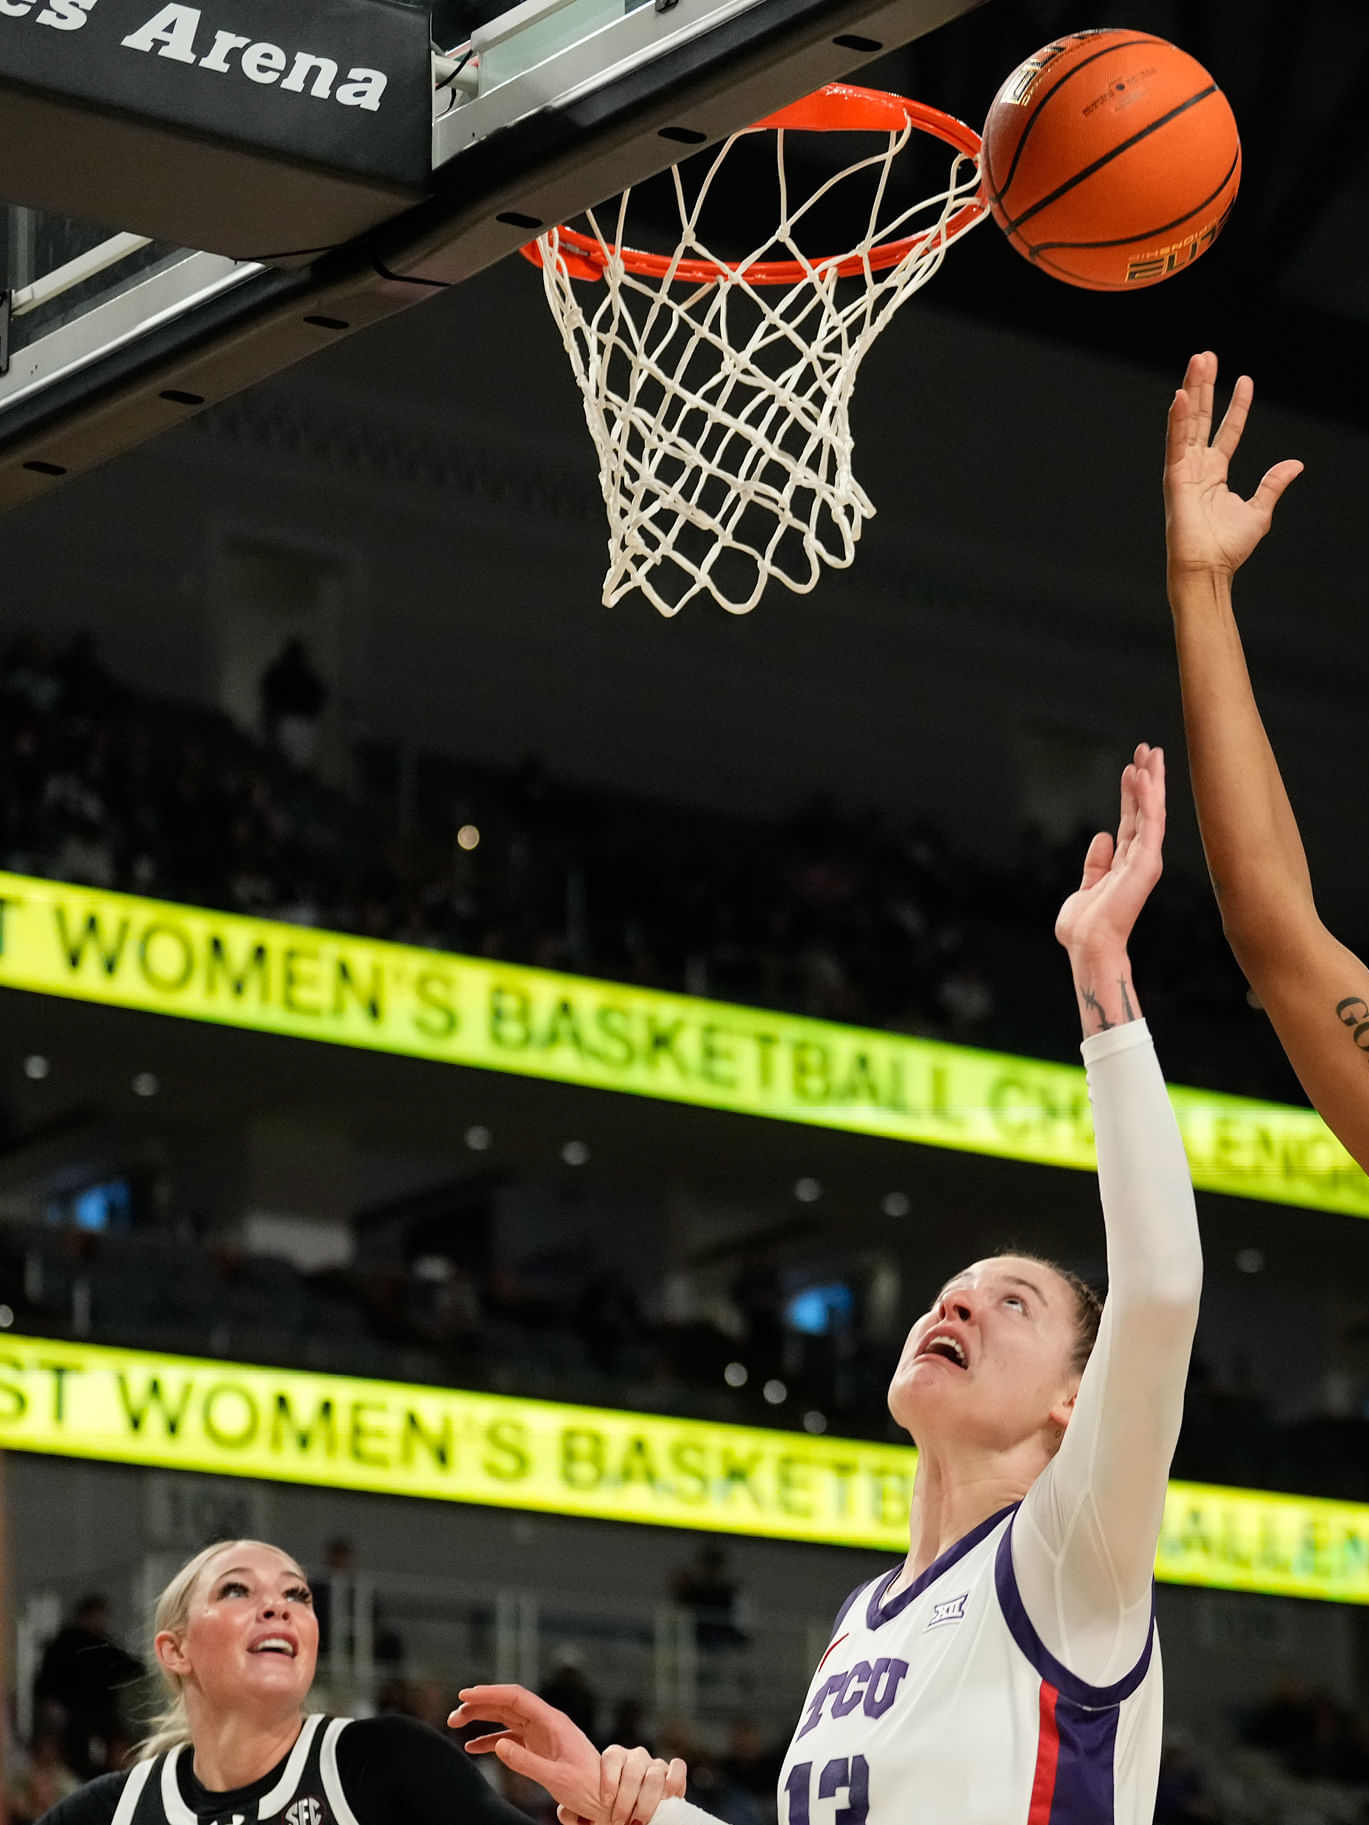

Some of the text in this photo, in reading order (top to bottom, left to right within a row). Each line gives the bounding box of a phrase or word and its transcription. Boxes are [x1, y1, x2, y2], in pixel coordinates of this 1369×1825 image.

[120, 2, 388, 112] Arena
[55, 904, 460, 1040] WOMEN'S
[489, 983, 964, 1130] BASKETBALL
[117, 1369, 531, 1482] WOMEN'S
[561, 1425, 909, 1528] BASKETB
[796, 1657, 909, 1743] TCU
